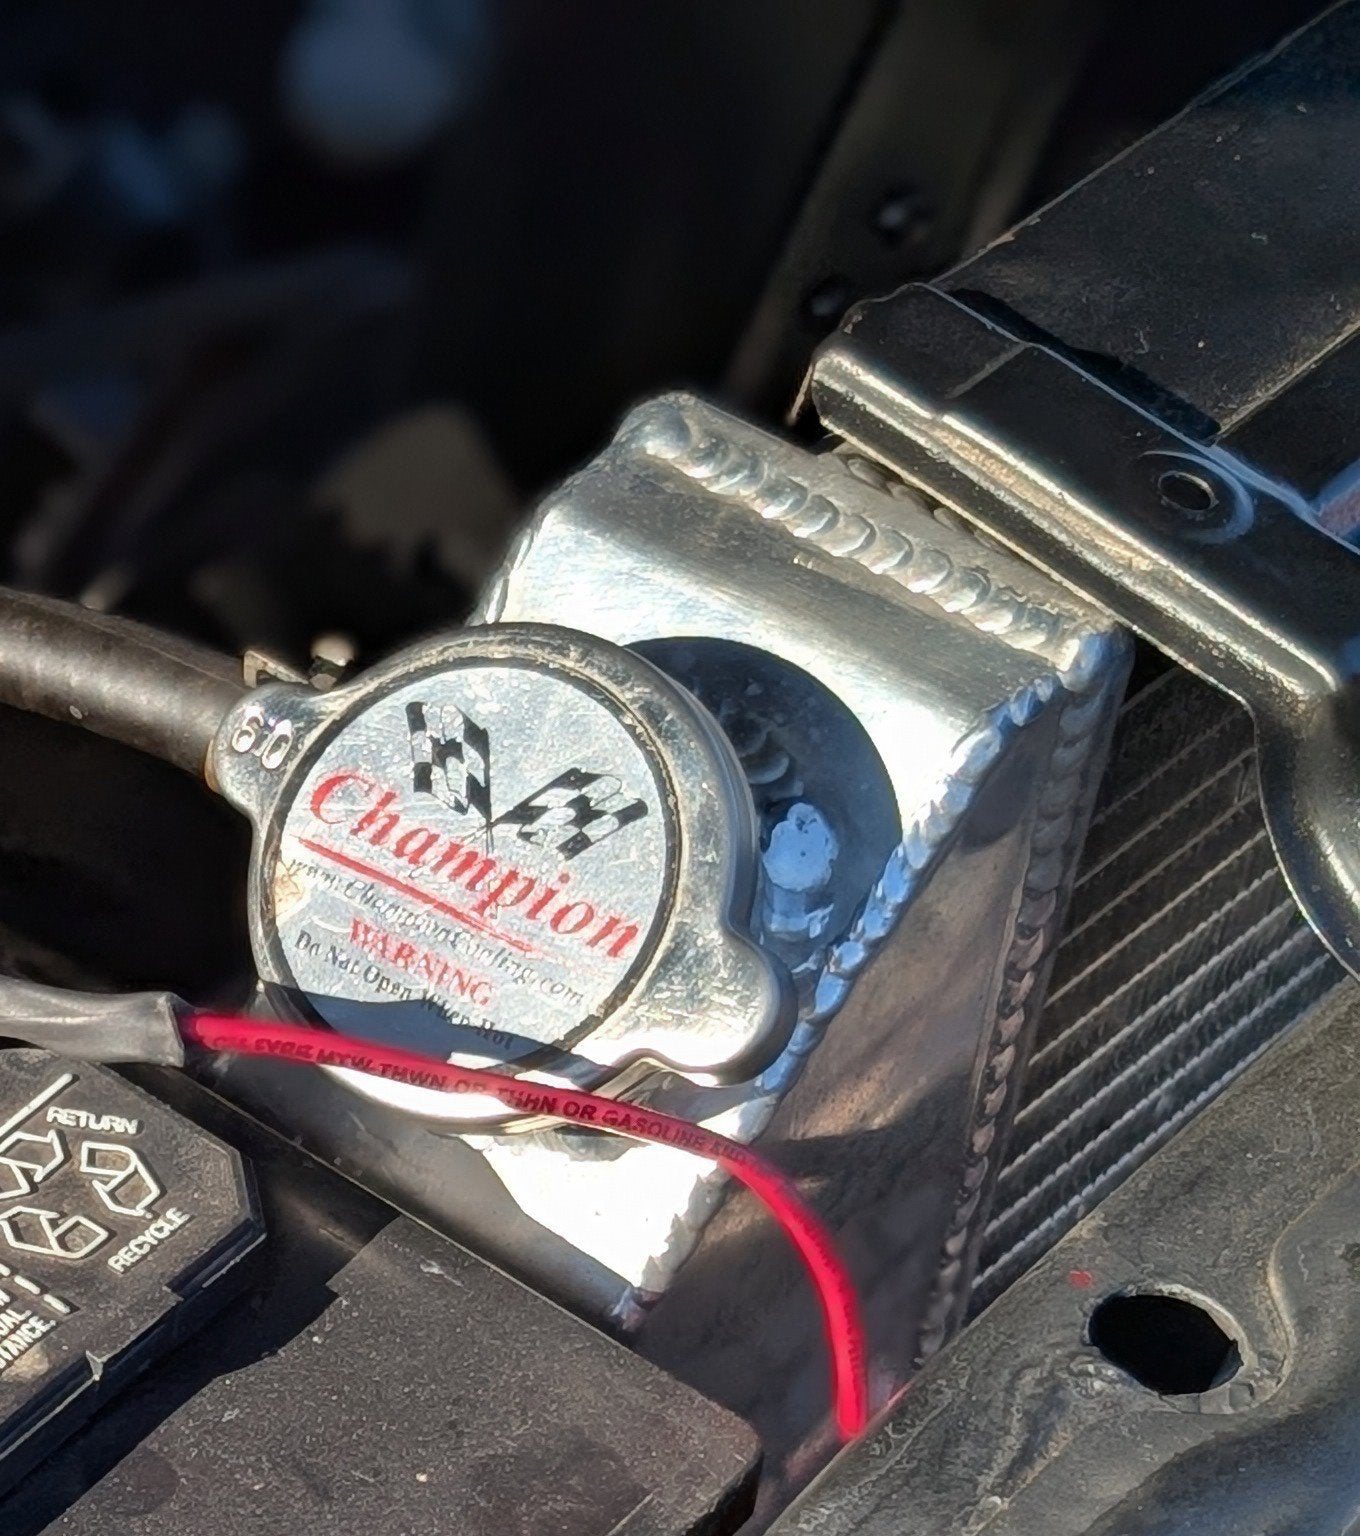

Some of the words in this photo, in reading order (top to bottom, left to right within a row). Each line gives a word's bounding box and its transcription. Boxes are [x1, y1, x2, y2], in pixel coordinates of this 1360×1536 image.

[310, 772, 639, 957] Champion
[295, 930, 321, 957] Do
[327, 944, 360, 976] Not
[363, 964, 413, 1000] Open
[420, 987, 470, 1026] When
[473, 1019, 514, 1049] Hot
[349, 918, 493, 1006] WARNING
[46, 1106, 139, 1135] RETURN
[563, 1099, 597, 1121] OR
[601, 1109, 707, 1148] GASOLINE
[107, 1207, 191, 1273] RECYCLE
